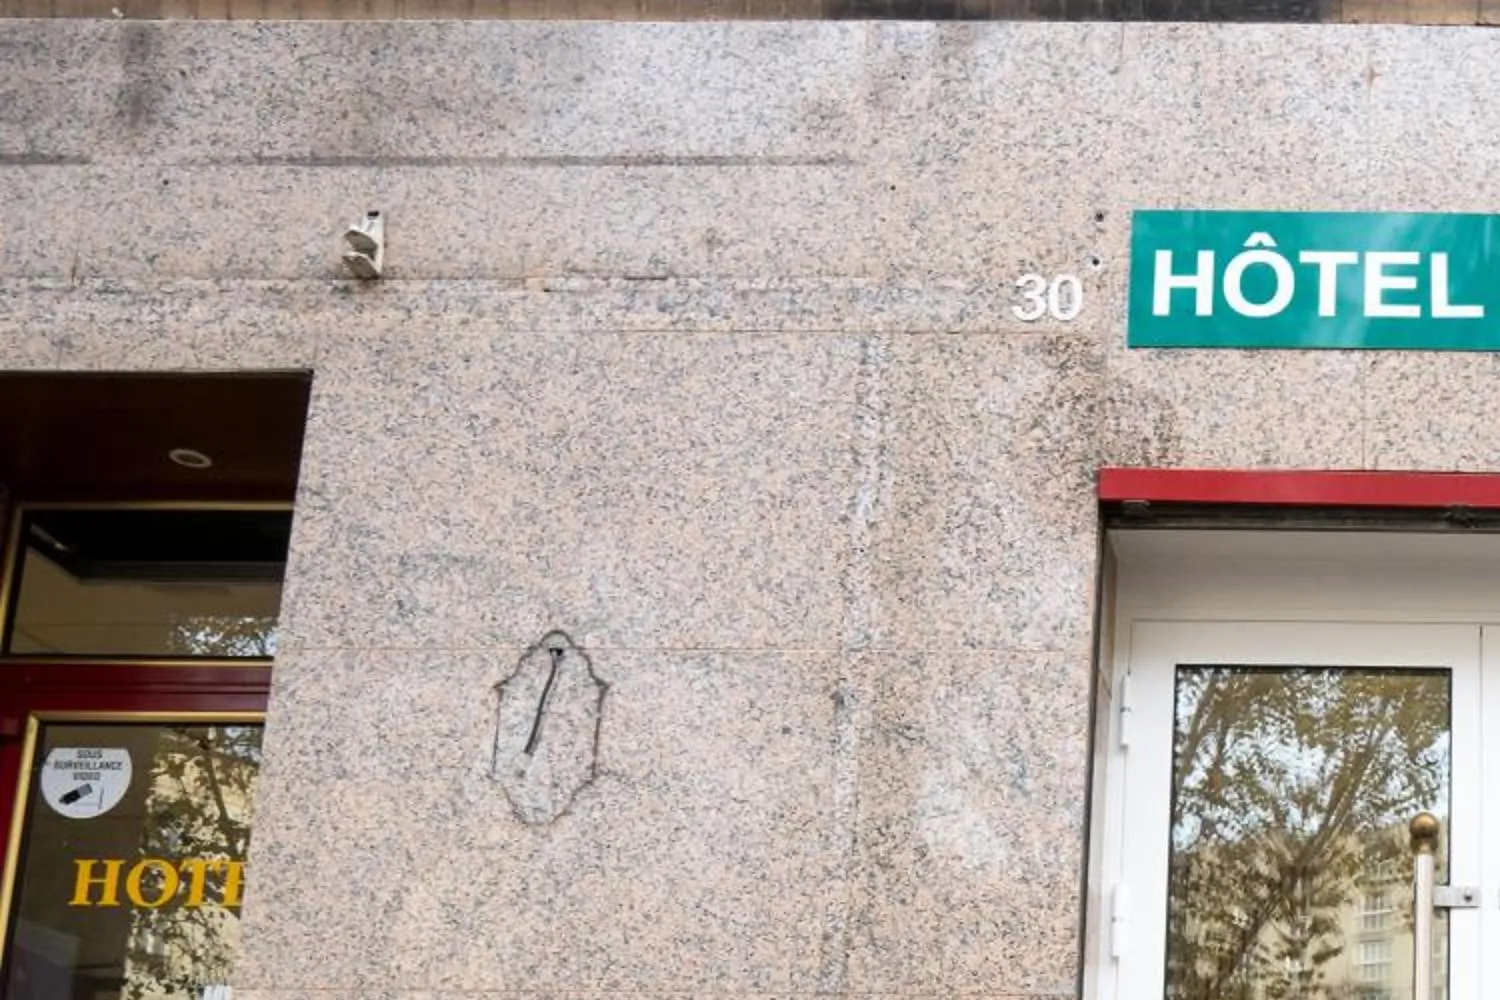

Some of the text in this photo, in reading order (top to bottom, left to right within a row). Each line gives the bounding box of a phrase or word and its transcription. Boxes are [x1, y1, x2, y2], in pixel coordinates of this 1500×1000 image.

[1011, 273, 1084, 322] 30
[1151, 231, 1485, 319] HÔTEL
[53, 760, 122, 770] SURVEILLANCE
